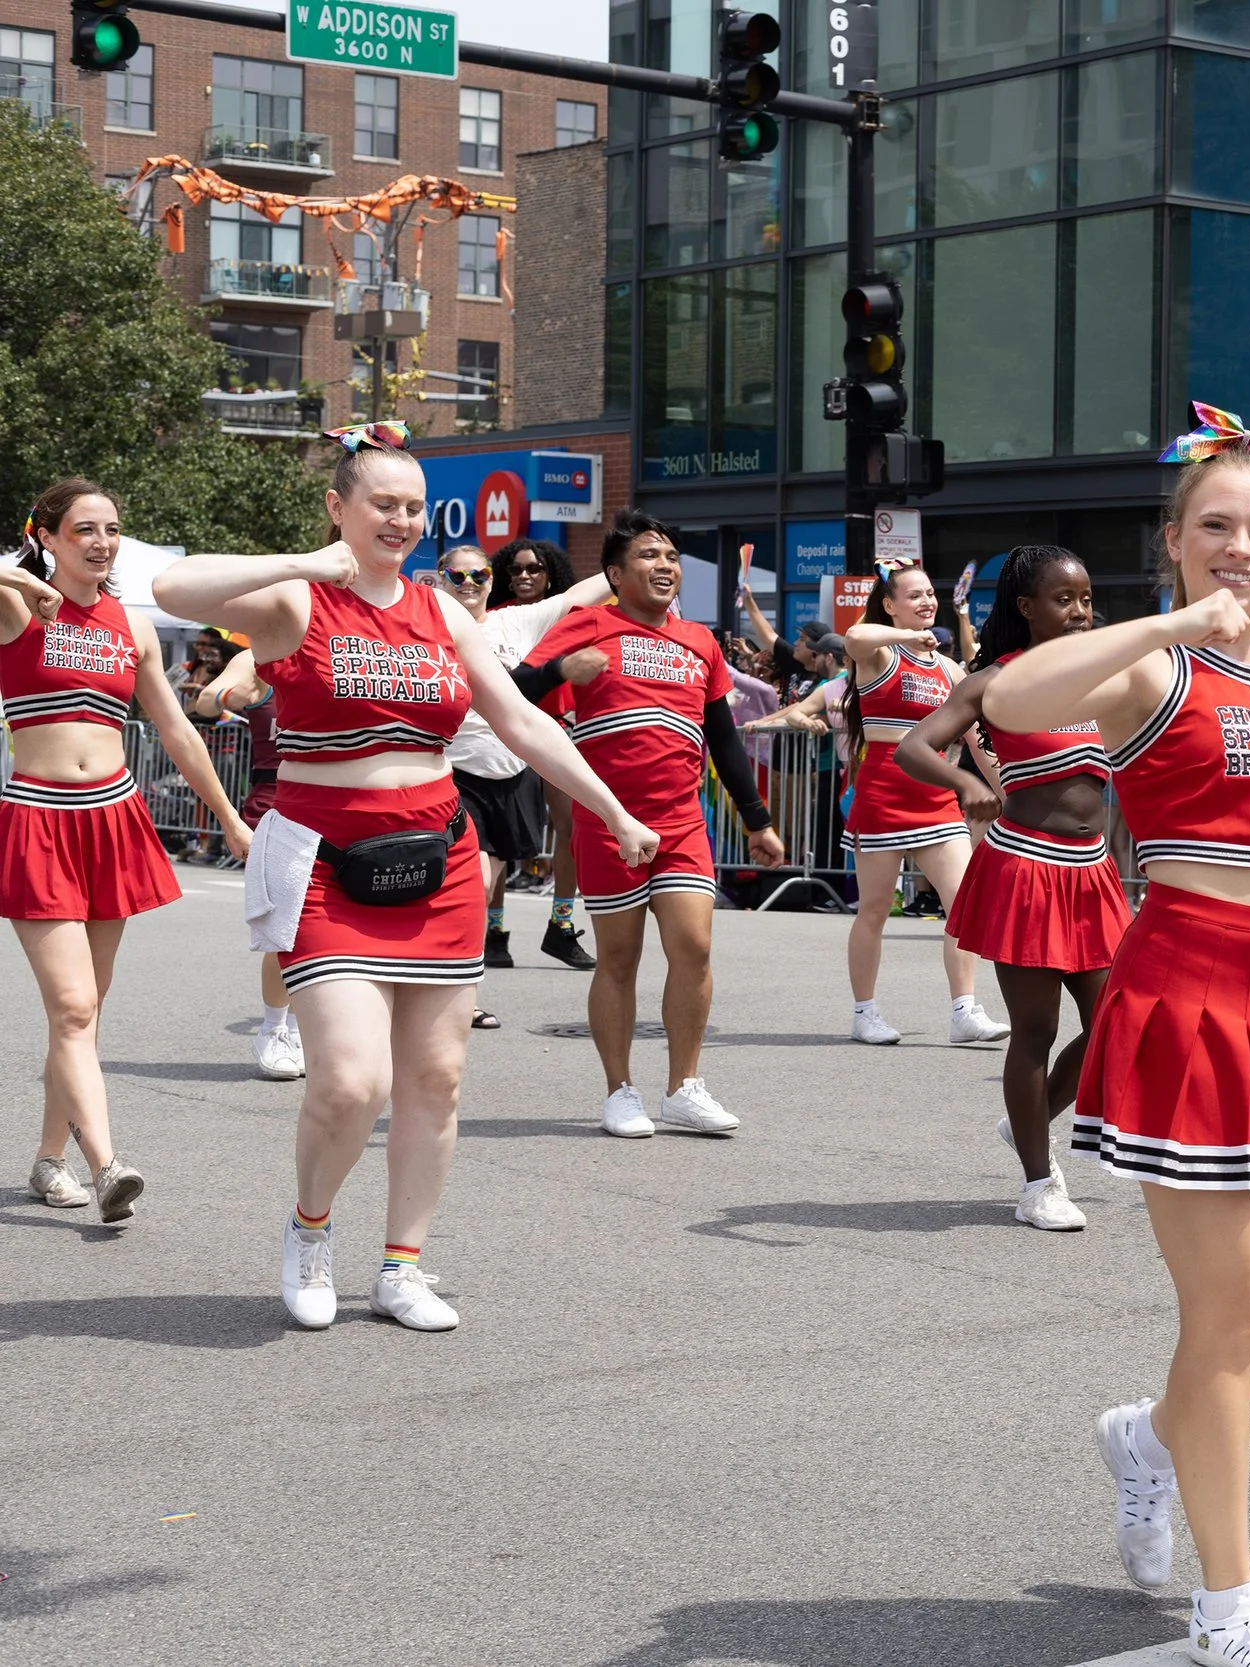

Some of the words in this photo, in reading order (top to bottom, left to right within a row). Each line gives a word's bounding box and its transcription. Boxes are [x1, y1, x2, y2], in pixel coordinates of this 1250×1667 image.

[297, 5, 310, 24] W
[317, 5, 422, 43] ADDISON
[429, 23, 449, 41] ST
[334, 38, 388, 61] 3600
[400, 46, 413, 65] N
[830, 0, 849, 86] 601
[662, 456, 690, 477] 3601
[711, 449, 760, 472] Halsted
[544, 473, 570, 484] BMO
[420, 498, 467, 539] MO
[556, 506, 577, 517] ATM
[797, 544, 827, 559] Deposit
[797, 564, 825, 578] Change
[45, 622, 112, 645] CHICAGO
[45, 637, 102, 657] SPIRIT
[329, 635, 430, 661] CHICAGO
[620, 634, 684, 656] CHICAGO
[43, 651, 115, 674] BRIGADE
[331, 656, 419, 679] SPIRIT
[622, 648, 674, 668] SPIRIT
[621, 661, 686, 684] BRIGADE
[900, 671, 938, 687] CHICAGO
[333, 676, 441, 703] BRIGADE
[901, 681, 933, 696] SPIRIT
[901, 691, 941, 708] BRIGADE
[372, 869, 427, 885] CHICAGO
